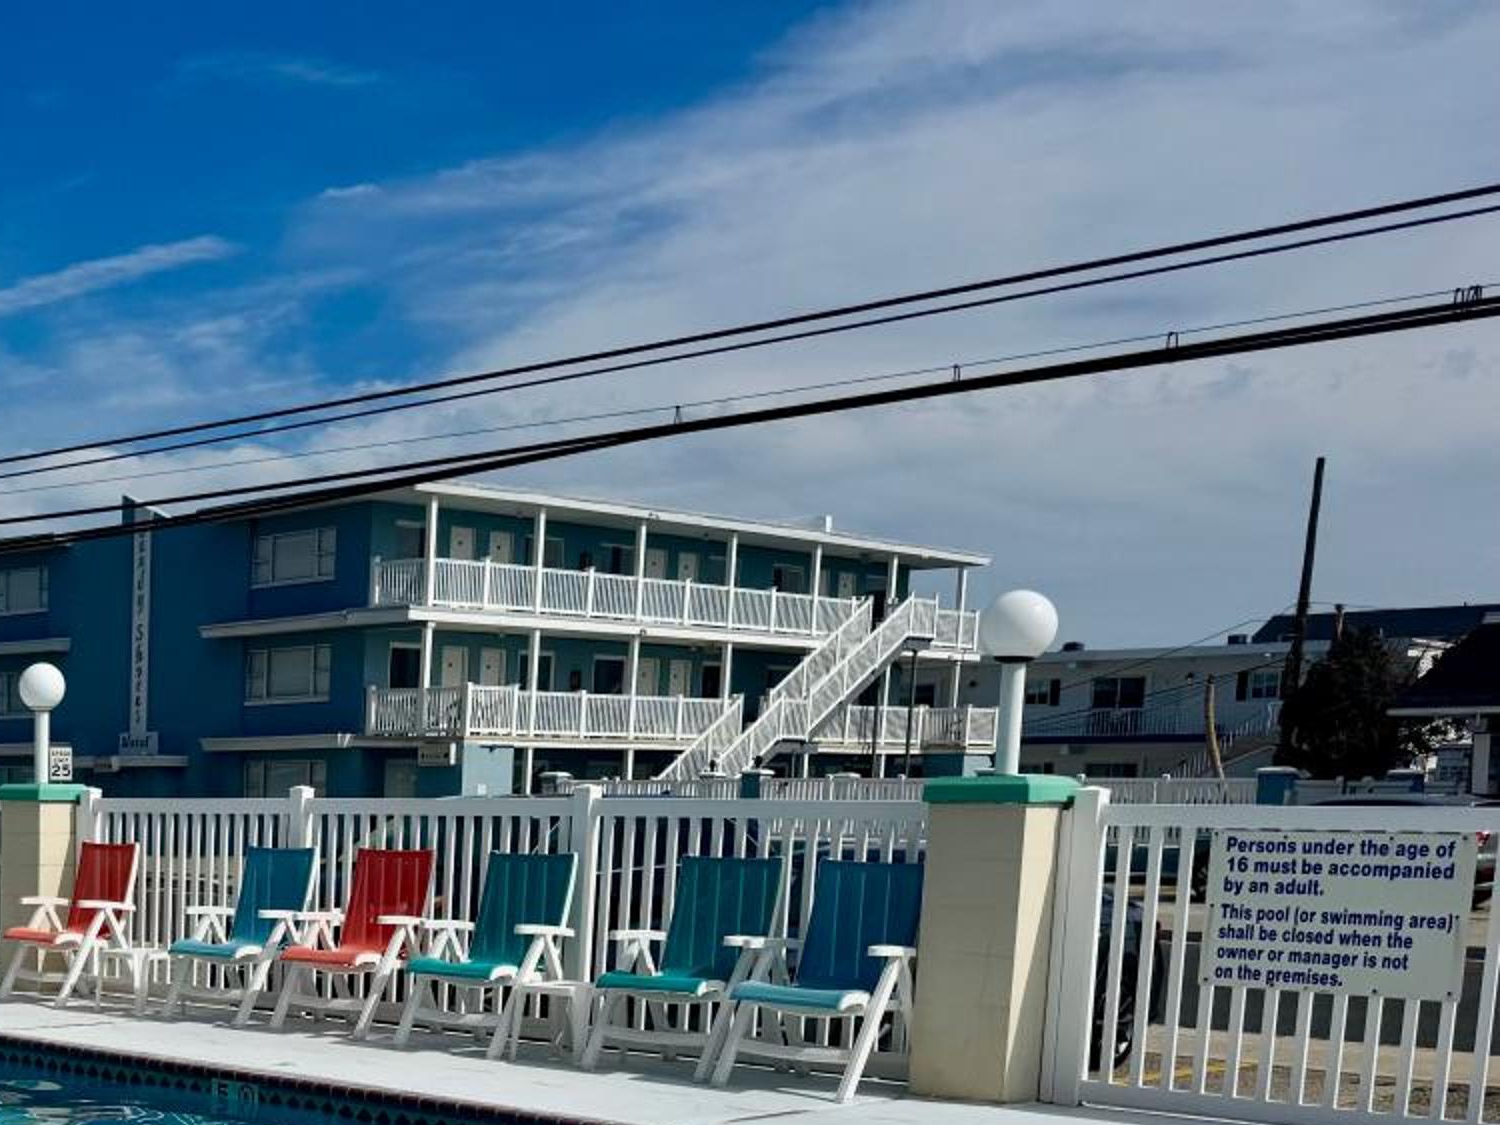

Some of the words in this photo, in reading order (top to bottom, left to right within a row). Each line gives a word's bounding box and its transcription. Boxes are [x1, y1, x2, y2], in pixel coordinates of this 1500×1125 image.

[51, 764, 71, 777] 25
[1226, 837, 1297, 853] Persons
[1302, 838, 1354, 855] under
[1360, 839, 1390, 856] the
[1395, 843, 1431, 860] age
[1435, 840, 1457, 858] of
[1227, 856, 1249, 873] 16
[1253, 858, 1298, 875] must
[1301, 859, 1323, 875] be
[1327, 862, 1456, 881] accompanied
[1223, 877, 1244, 896] by
[1249, 880, 1269, 893] an
[1274, 879, 1325, 896] adult.
[1221, 904, 1252, 920] This
[1256, 905, 1290, 924] pool
[1293, 906, 1315, 924] (or
[1320, 909, 1405, 931] swimming
[1408, 914, 1454, 933] area)
[1217, 923, 1255, 940] shall
[1258, 926, 1278, 942] be
[1281, 927, 1334, 945] closed
[1339, 930, 1383, 948] when
[1387, 930, 1414, 949] the
[1216, 947, 1263, 961] owner
[1267, 950, 1285, 962] or
[1288, 951, 1359, 969] manager
[1363, 951, 1378, 967] is
[1382, 954, 1409, 971] not
[1214, 966, 1233, 979] on
[1237, 965, 1261, 981] the
[1266, 969, 1343, 987] premises.
